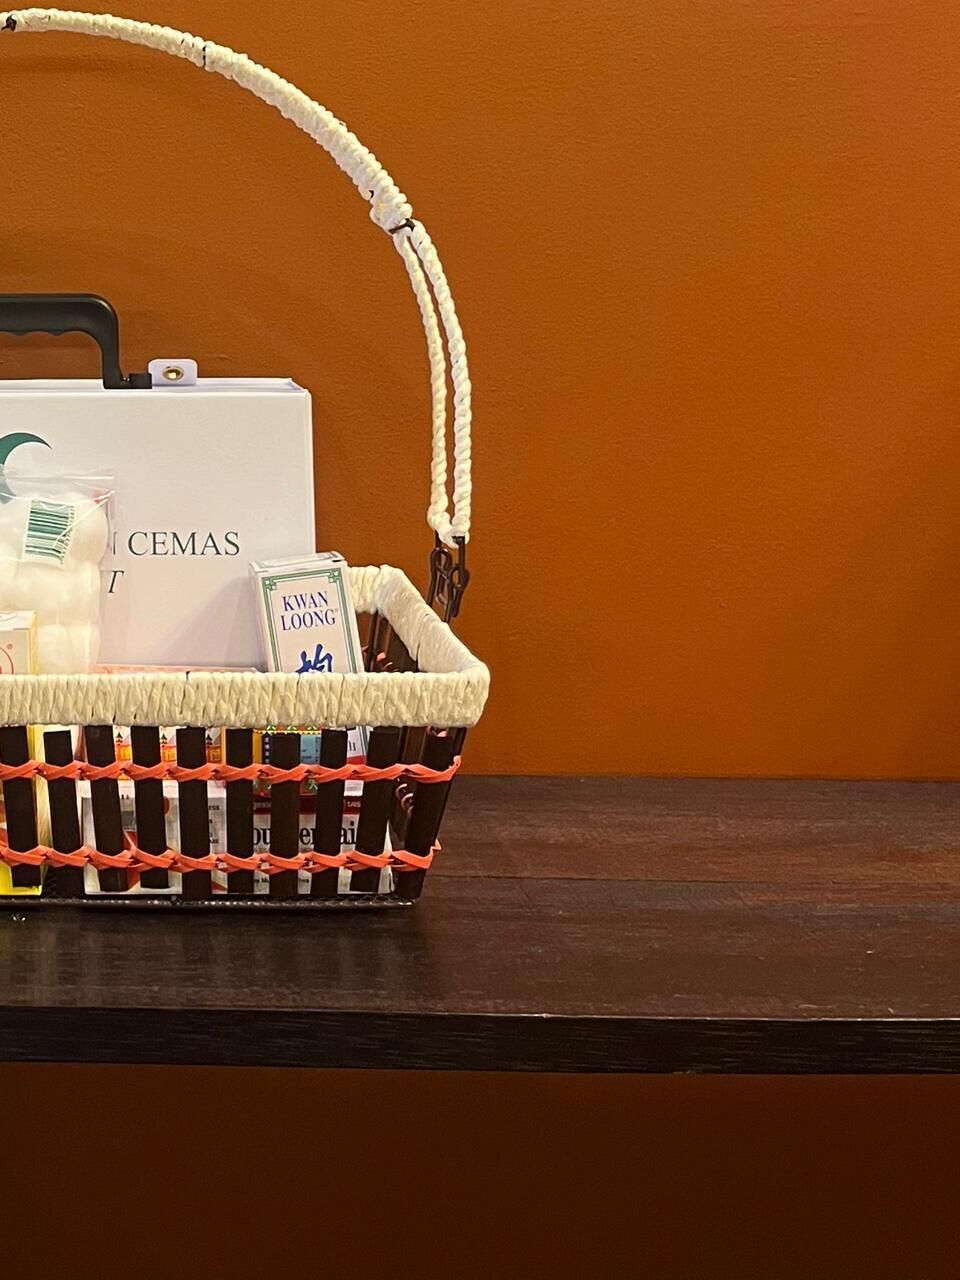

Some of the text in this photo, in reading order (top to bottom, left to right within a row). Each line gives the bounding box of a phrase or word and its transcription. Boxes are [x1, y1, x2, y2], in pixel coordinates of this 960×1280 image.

[127, 530, 241, 556] CEMAS
[281, 590, 329, 612] KWAN
[279, 608, 337, 631] LOONG
